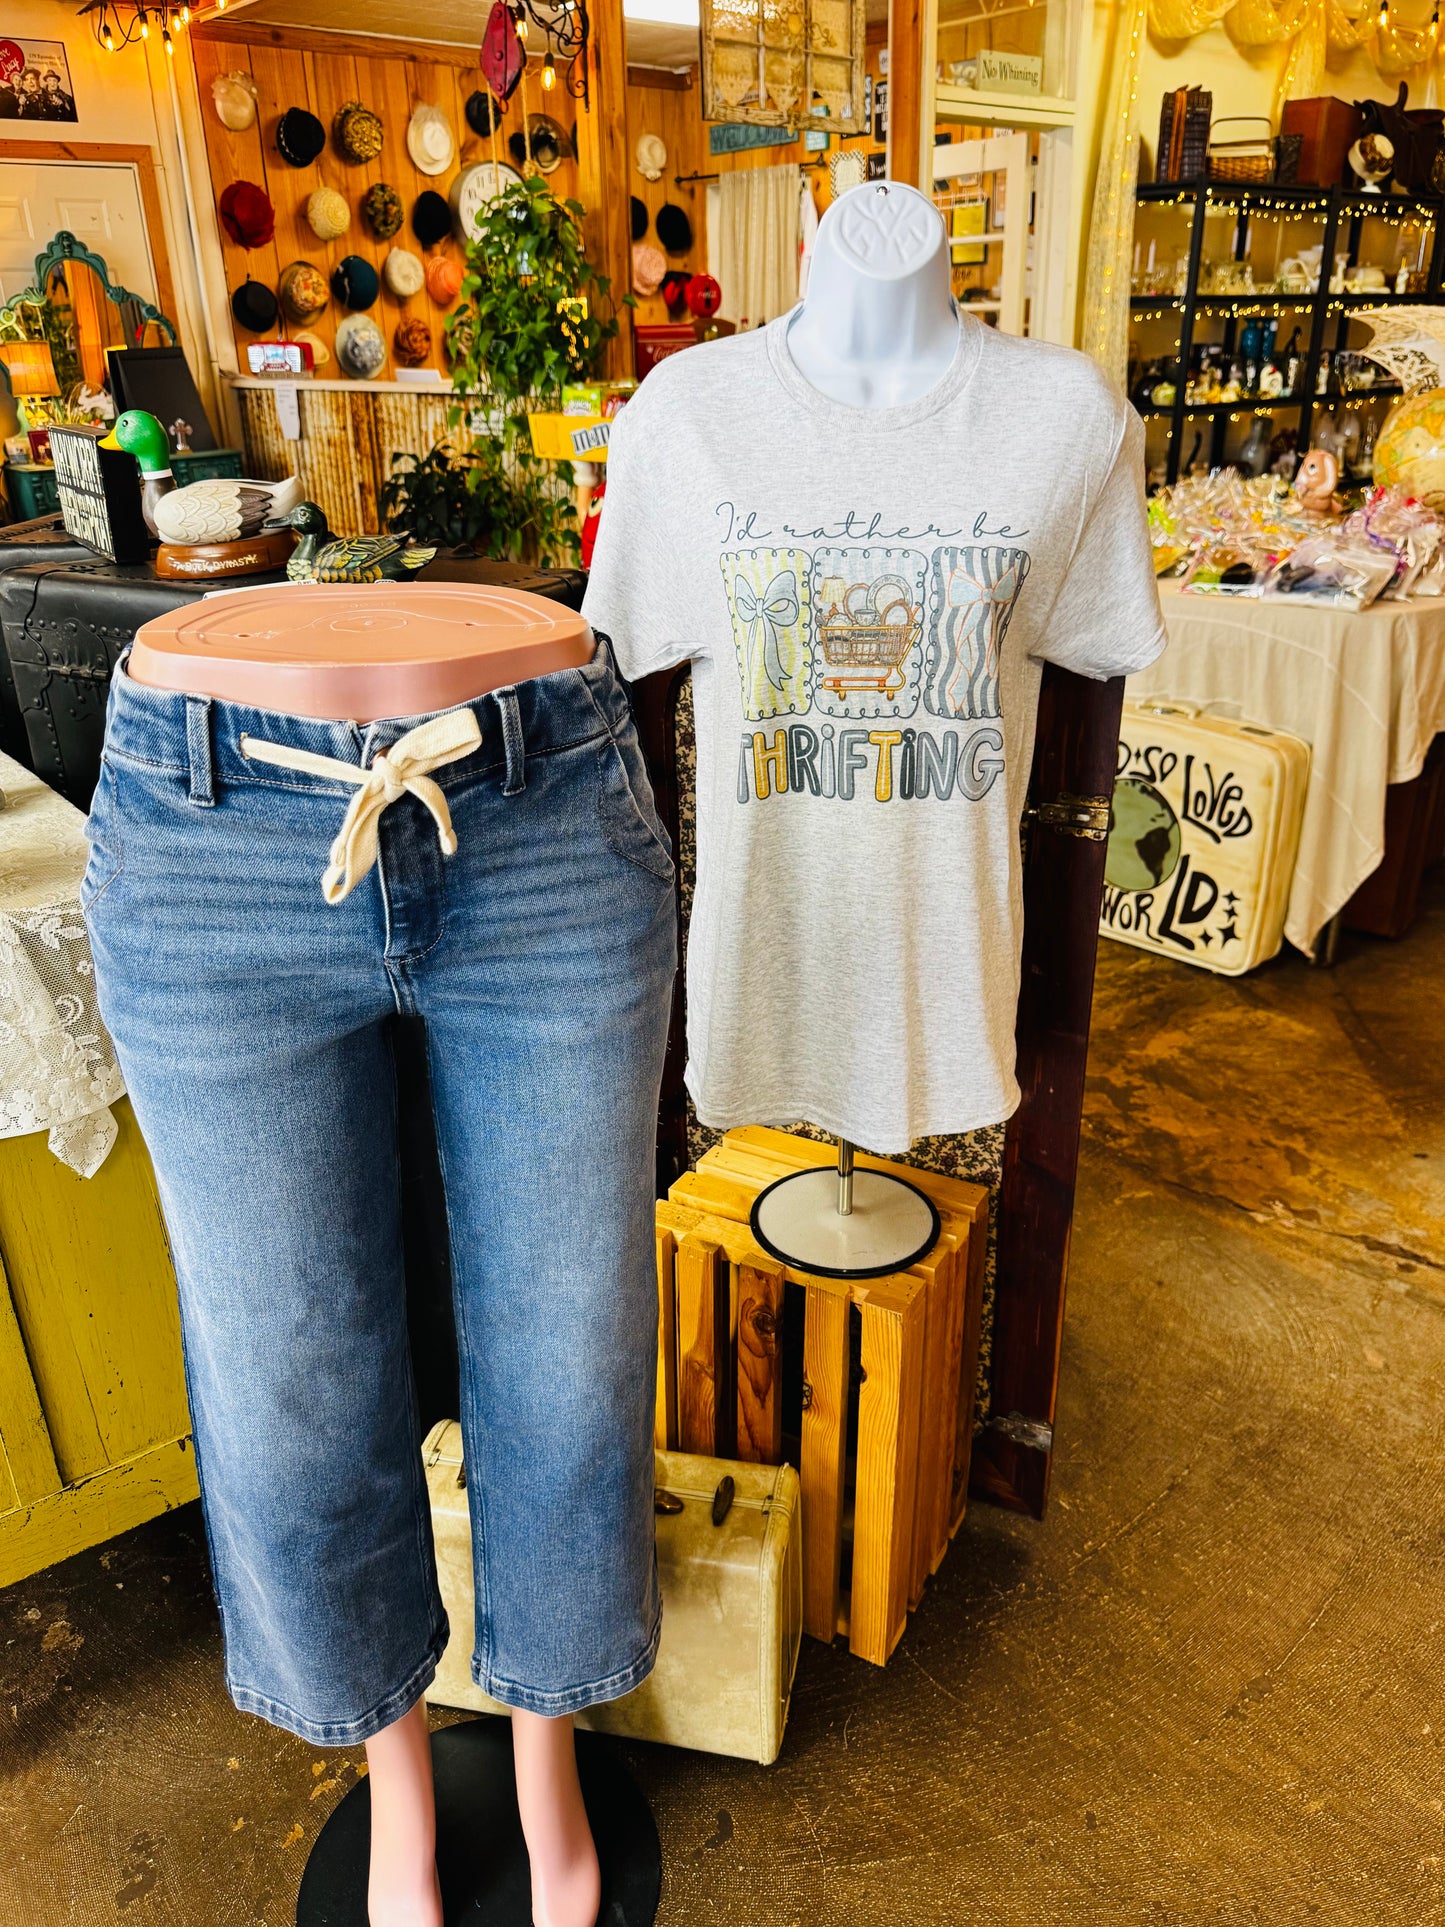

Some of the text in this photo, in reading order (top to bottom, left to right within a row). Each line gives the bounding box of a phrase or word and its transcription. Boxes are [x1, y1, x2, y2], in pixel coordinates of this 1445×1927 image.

[981, 59, 997, 79] No
[999, 61, 1039, 87] Whining
[715, 502, 1029, 544] I'd rather be
